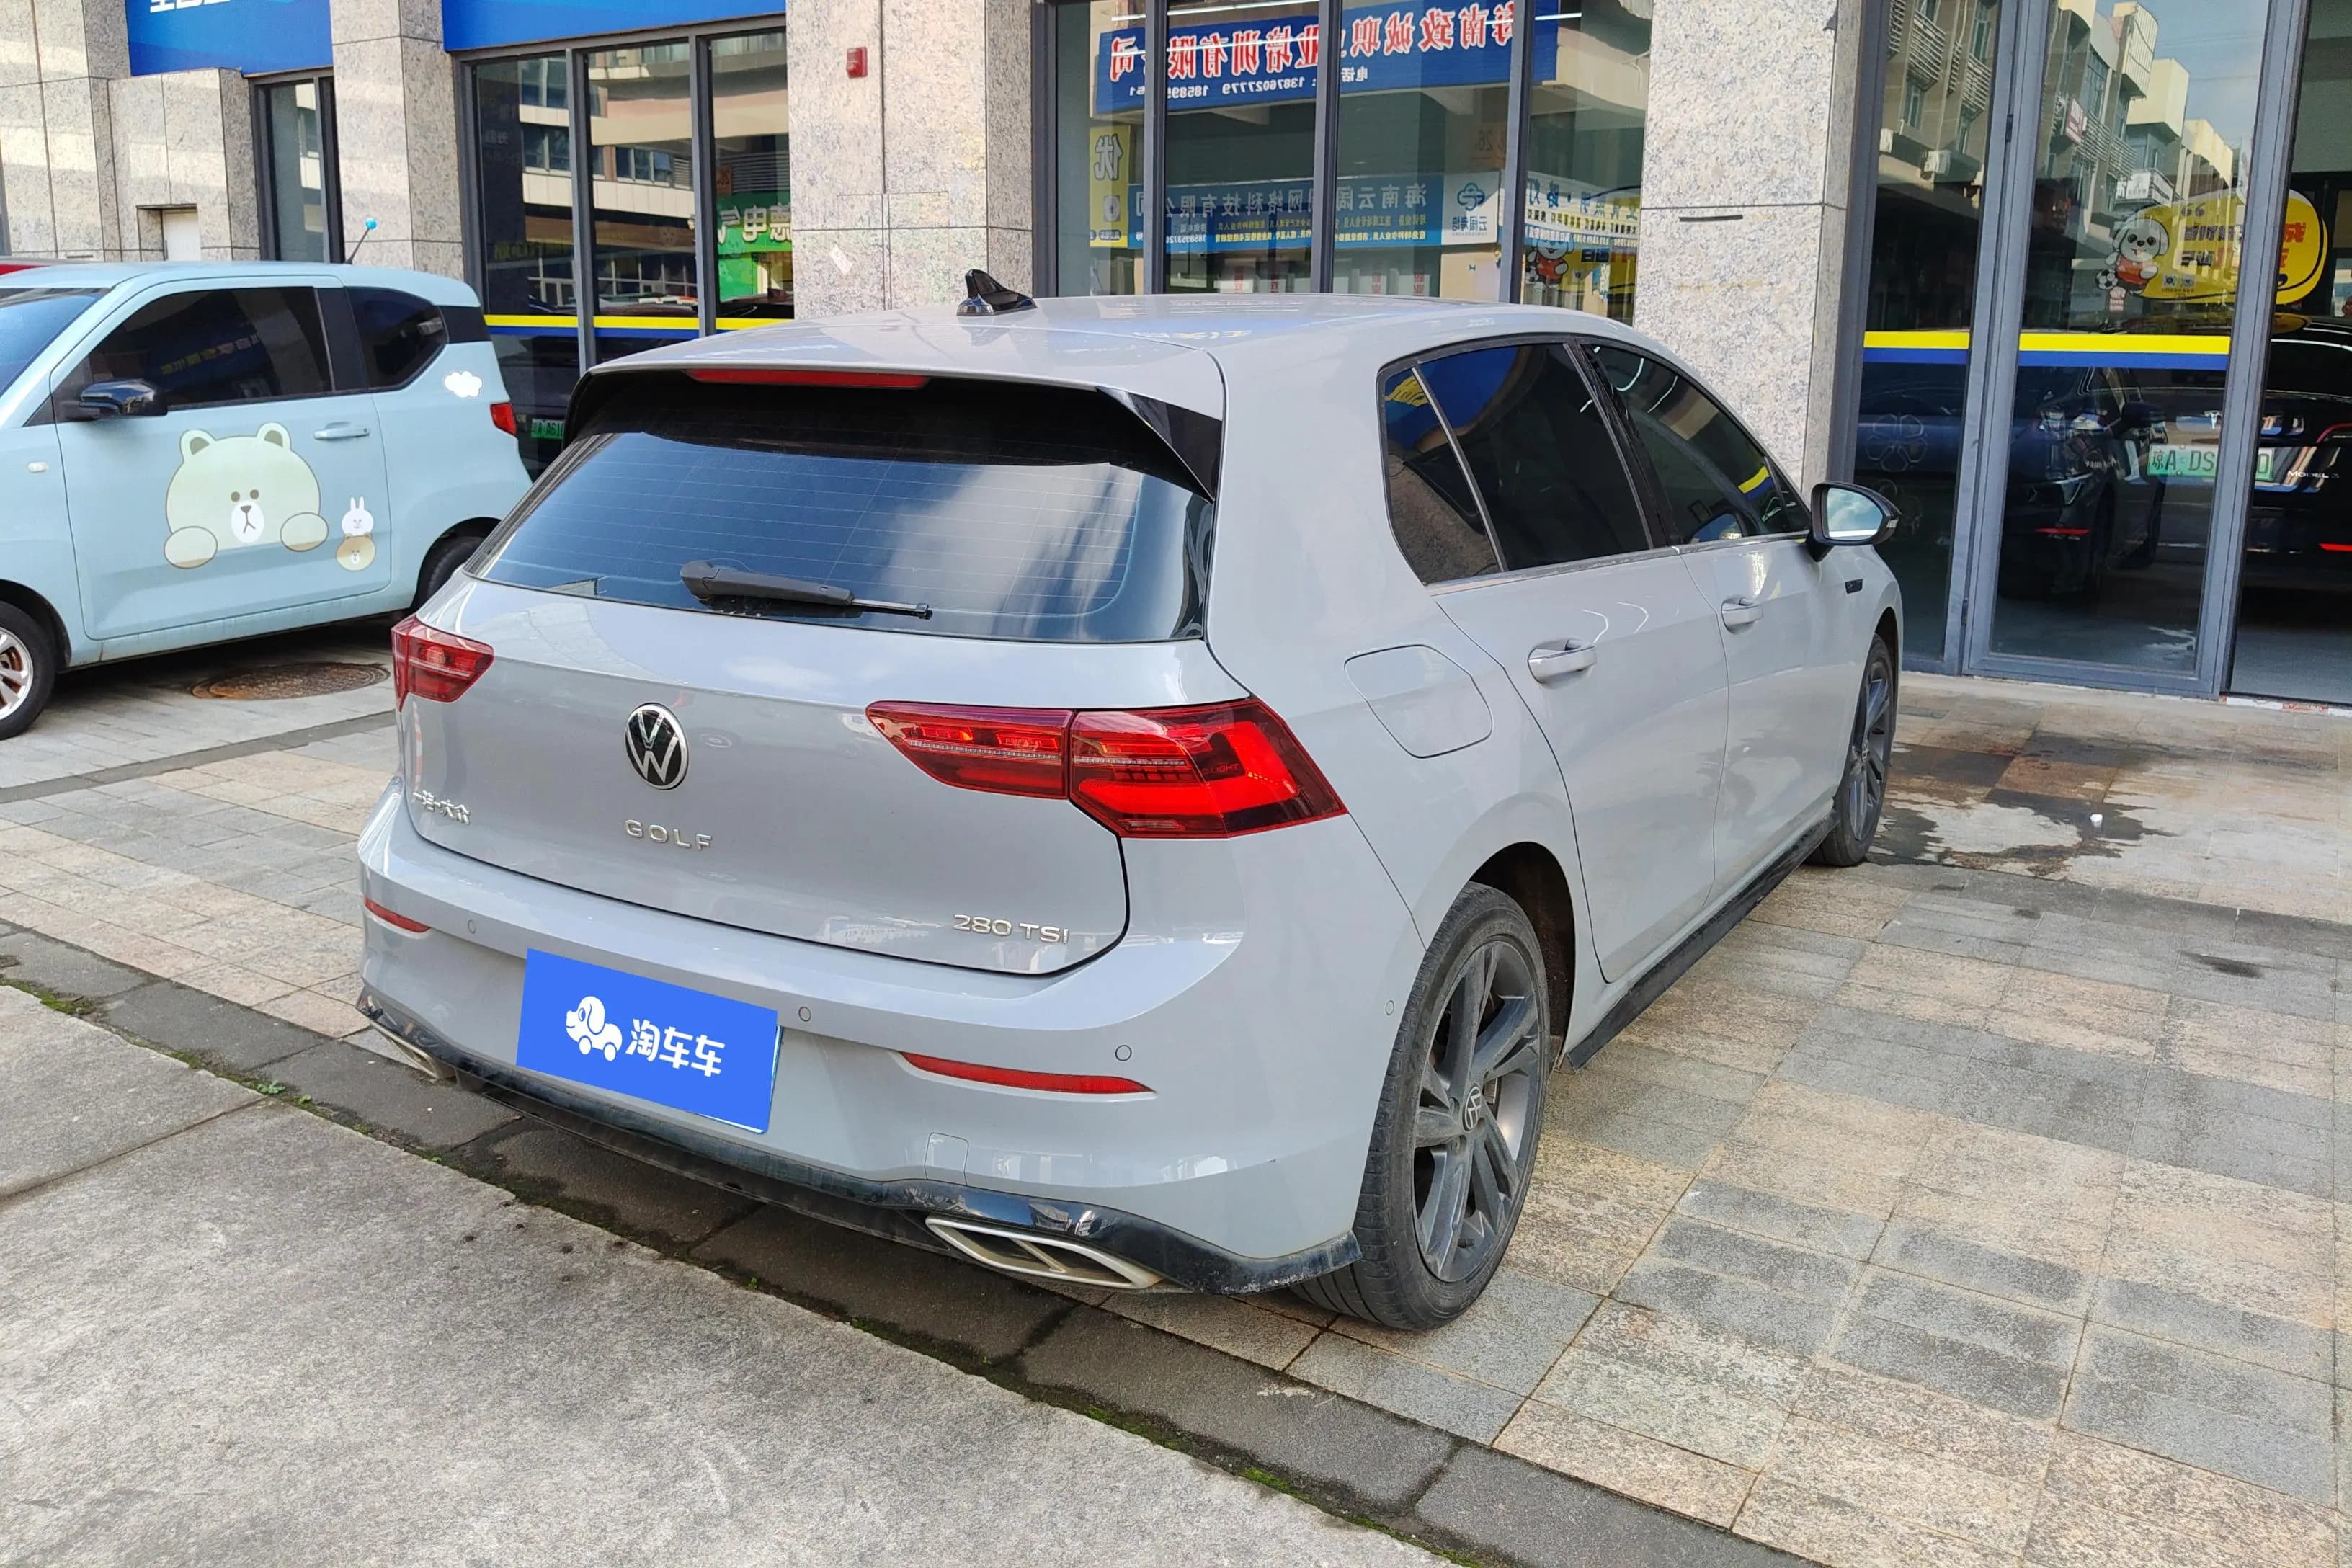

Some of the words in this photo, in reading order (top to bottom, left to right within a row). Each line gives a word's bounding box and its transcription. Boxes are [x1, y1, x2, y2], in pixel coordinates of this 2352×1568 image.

[625, 819, 713, 851] GOLF
[953, 914, 1012, 936] 280
[1020, 922, 1070, 944] TSI
